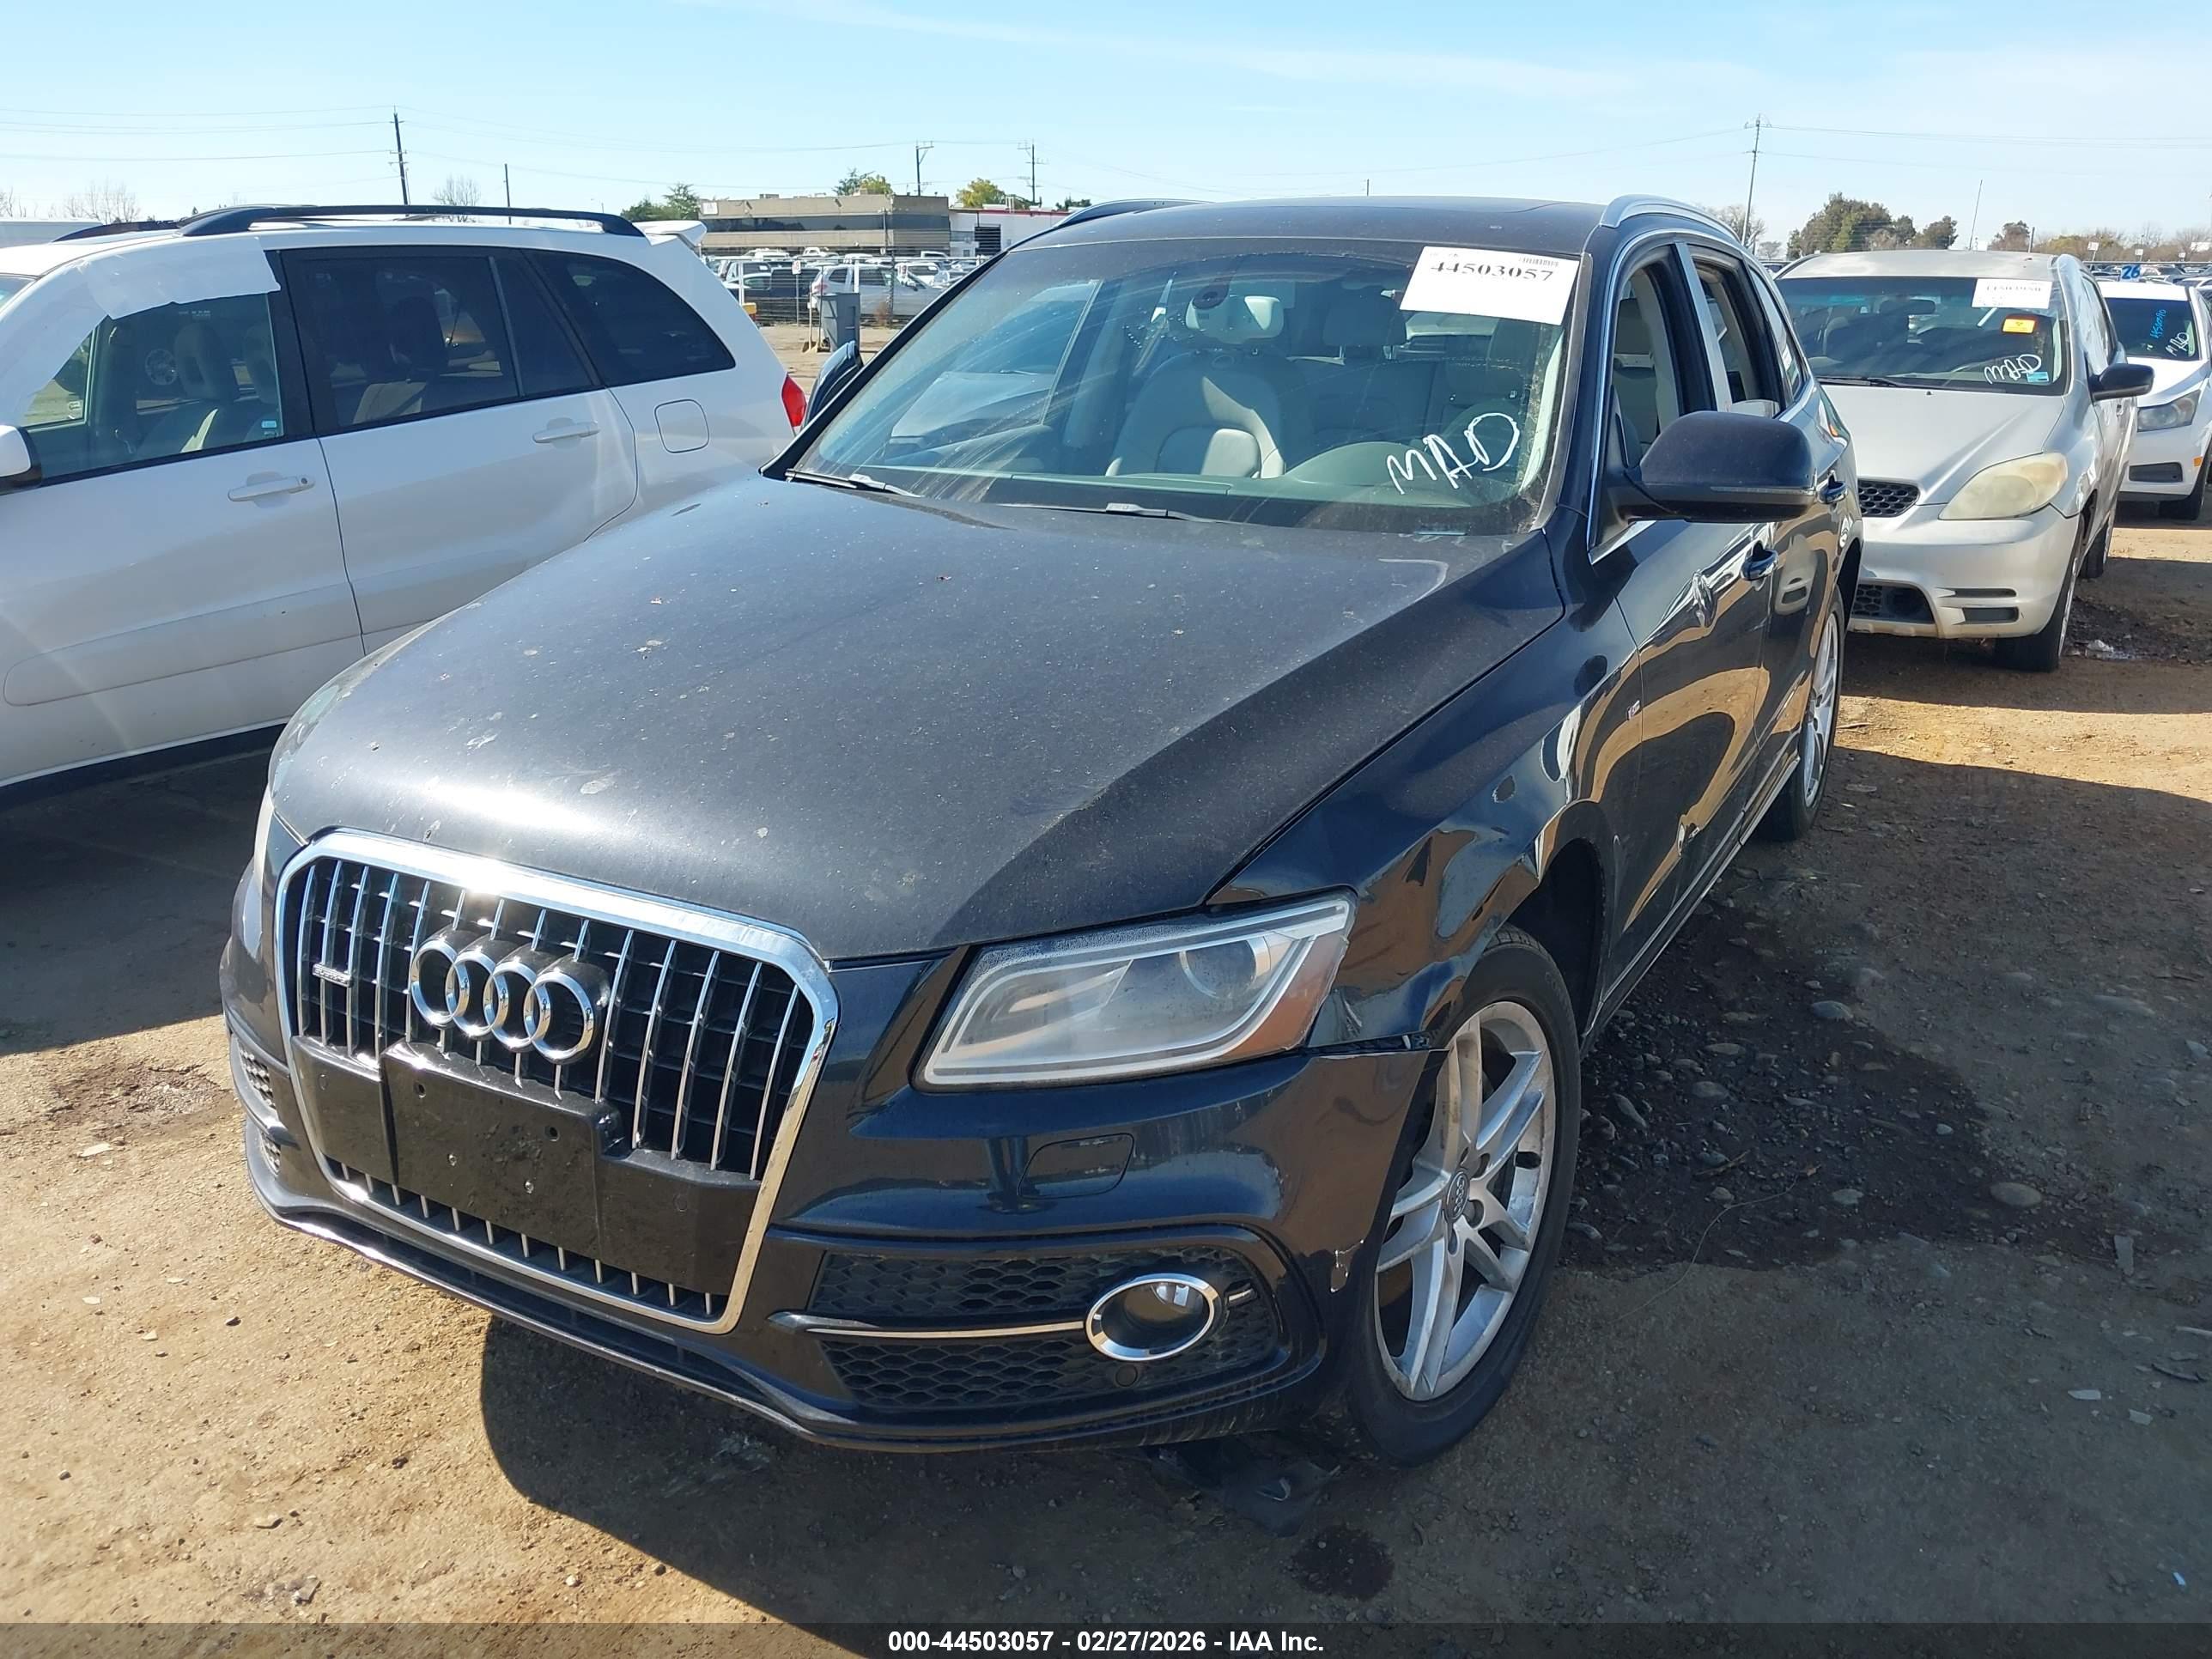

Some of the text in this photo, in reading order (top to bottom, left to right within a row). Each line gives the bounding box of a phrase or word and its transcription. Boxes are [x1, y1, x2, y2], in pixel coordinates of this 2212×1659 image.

[1430, 261, 1554, 282] 44503057
[2121, 265, 2141, 279] 26
[1386, 411, 1521, 495] MAD
